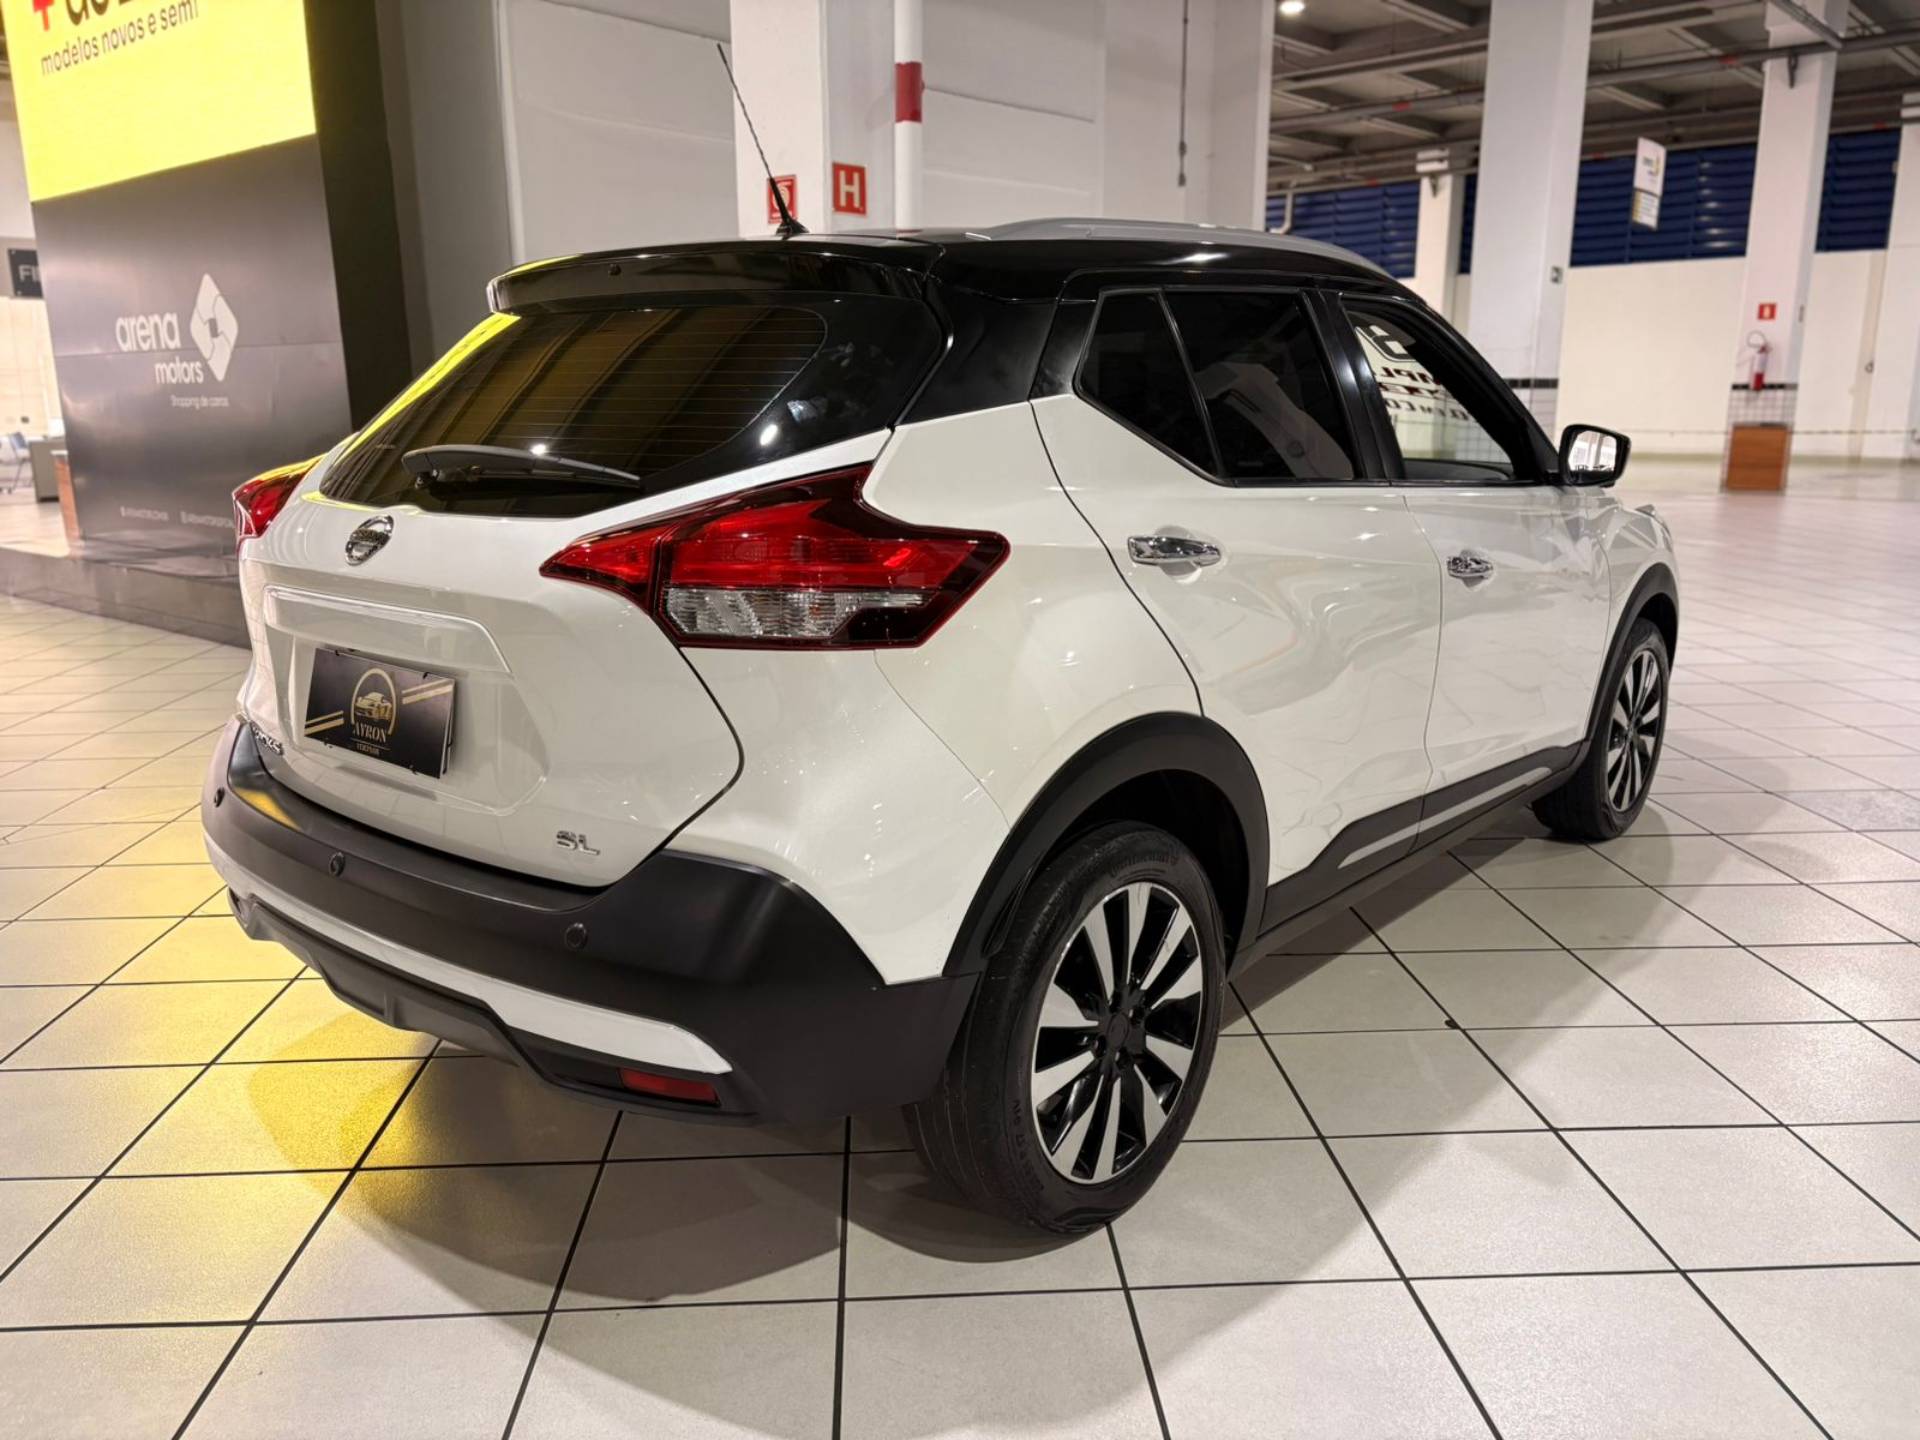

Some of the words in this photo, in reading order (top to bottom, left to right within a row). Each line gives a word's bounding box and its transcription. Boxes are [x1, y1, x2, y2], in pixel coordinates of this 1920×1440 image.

[41, 36, 99, 75] modelos
[101, 17, 145, 53] novos
[147, 12, 157, 35] e
[839, 169, 861, 208] H
[115, 312, 182, 352] arena
[154, 355, 205, 385] motors
[556, 830, 601, 856] SL
